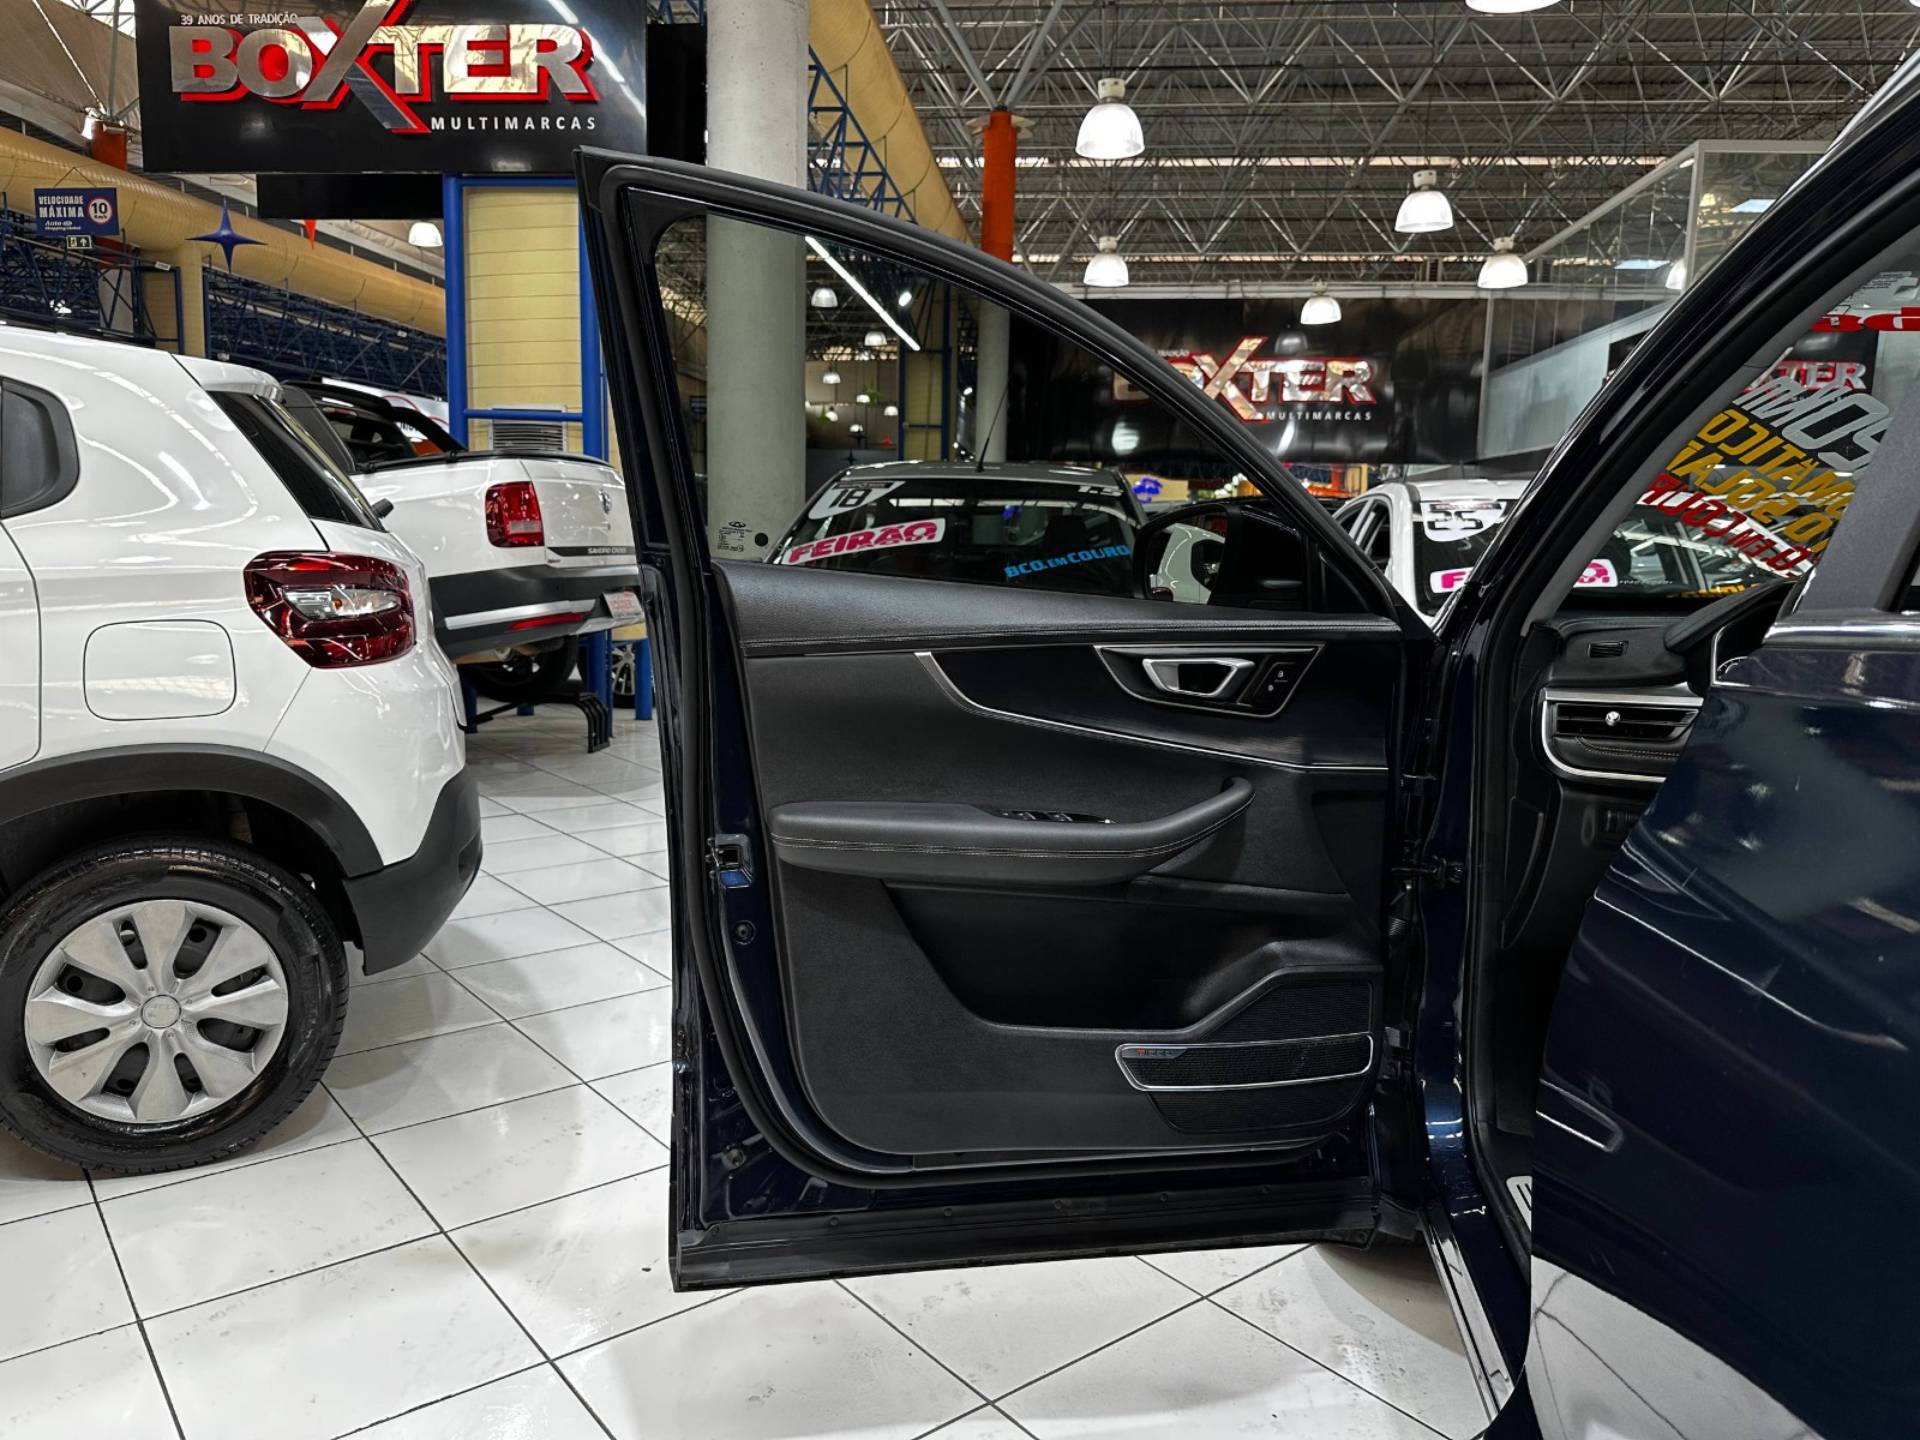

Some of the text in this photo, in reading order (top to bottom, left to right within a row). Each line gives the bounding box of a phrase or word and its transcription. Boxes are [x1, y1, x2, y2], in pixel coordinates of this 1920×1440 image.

[180, 11, 299, 26] 39 ANOS DE TRADIÇÃO
[168, 0, 598, 134] BOXTER
[430, 116, 597, 131] MULTIMARCAS
[38, 195, 84, 205] VELOCIDADE
[39, 205, 85, 218] MÁXIMA
[91, 202, 108, 215] 10
[1113, 336, 1376, 422] XTER
[1266, 410, 1373, 421] MULTIMARCAS
[828, 488, 872, 509] 18
[1066, 544, 1131, 563] COURO
